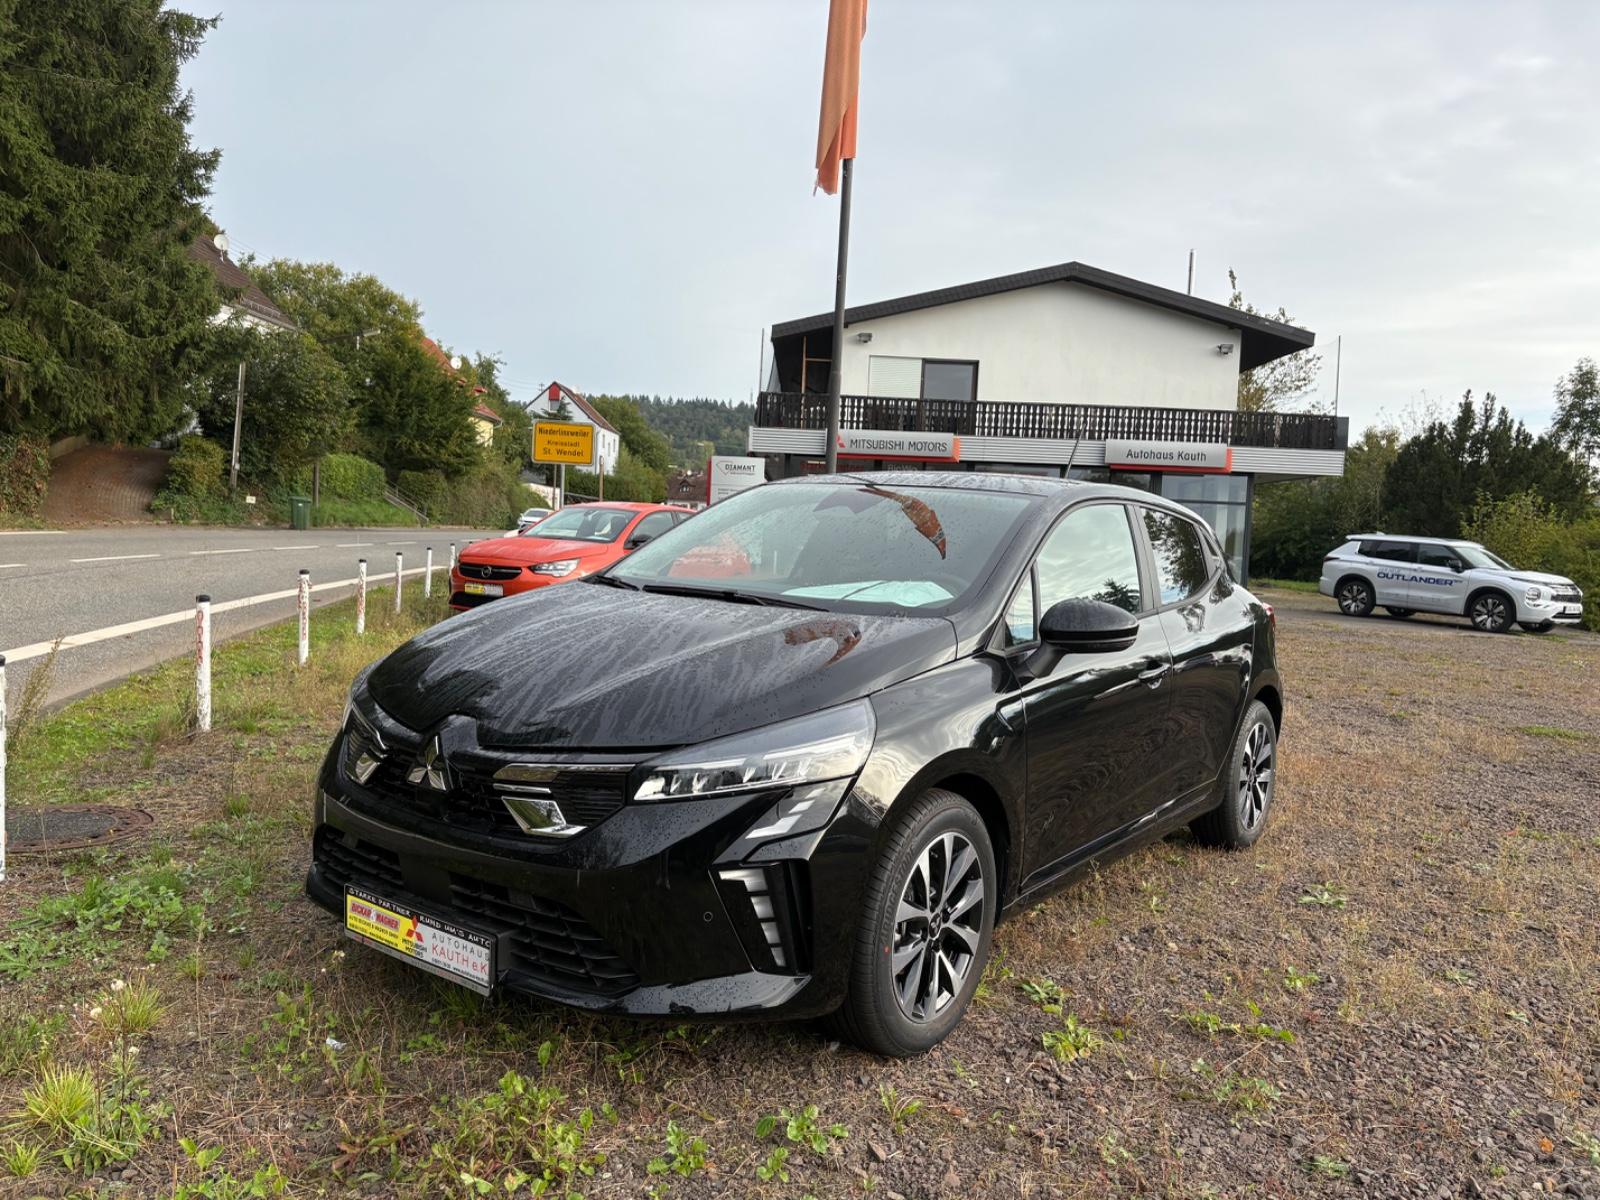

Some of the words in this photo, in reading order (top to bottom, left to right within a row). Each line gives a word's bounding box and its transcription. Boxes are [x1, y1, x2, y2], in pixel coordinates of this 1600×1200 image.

[849, 438, 904, 451] MITSUBISHI
[908, 440, 948, 452] MOTORS
[556, 449, 584, 457] Wendel
[1126, 448, 1174, 461] Autohaus
[1177, 450, 1207, 462] Kauth
[725, 463, 756, 473] DIAMANT
[1377, 571, 1454, 587] OUTLANDER
[432, 932, 491, 962] AUTOHAUS
[432, 943, 469, 968] KAUTH
